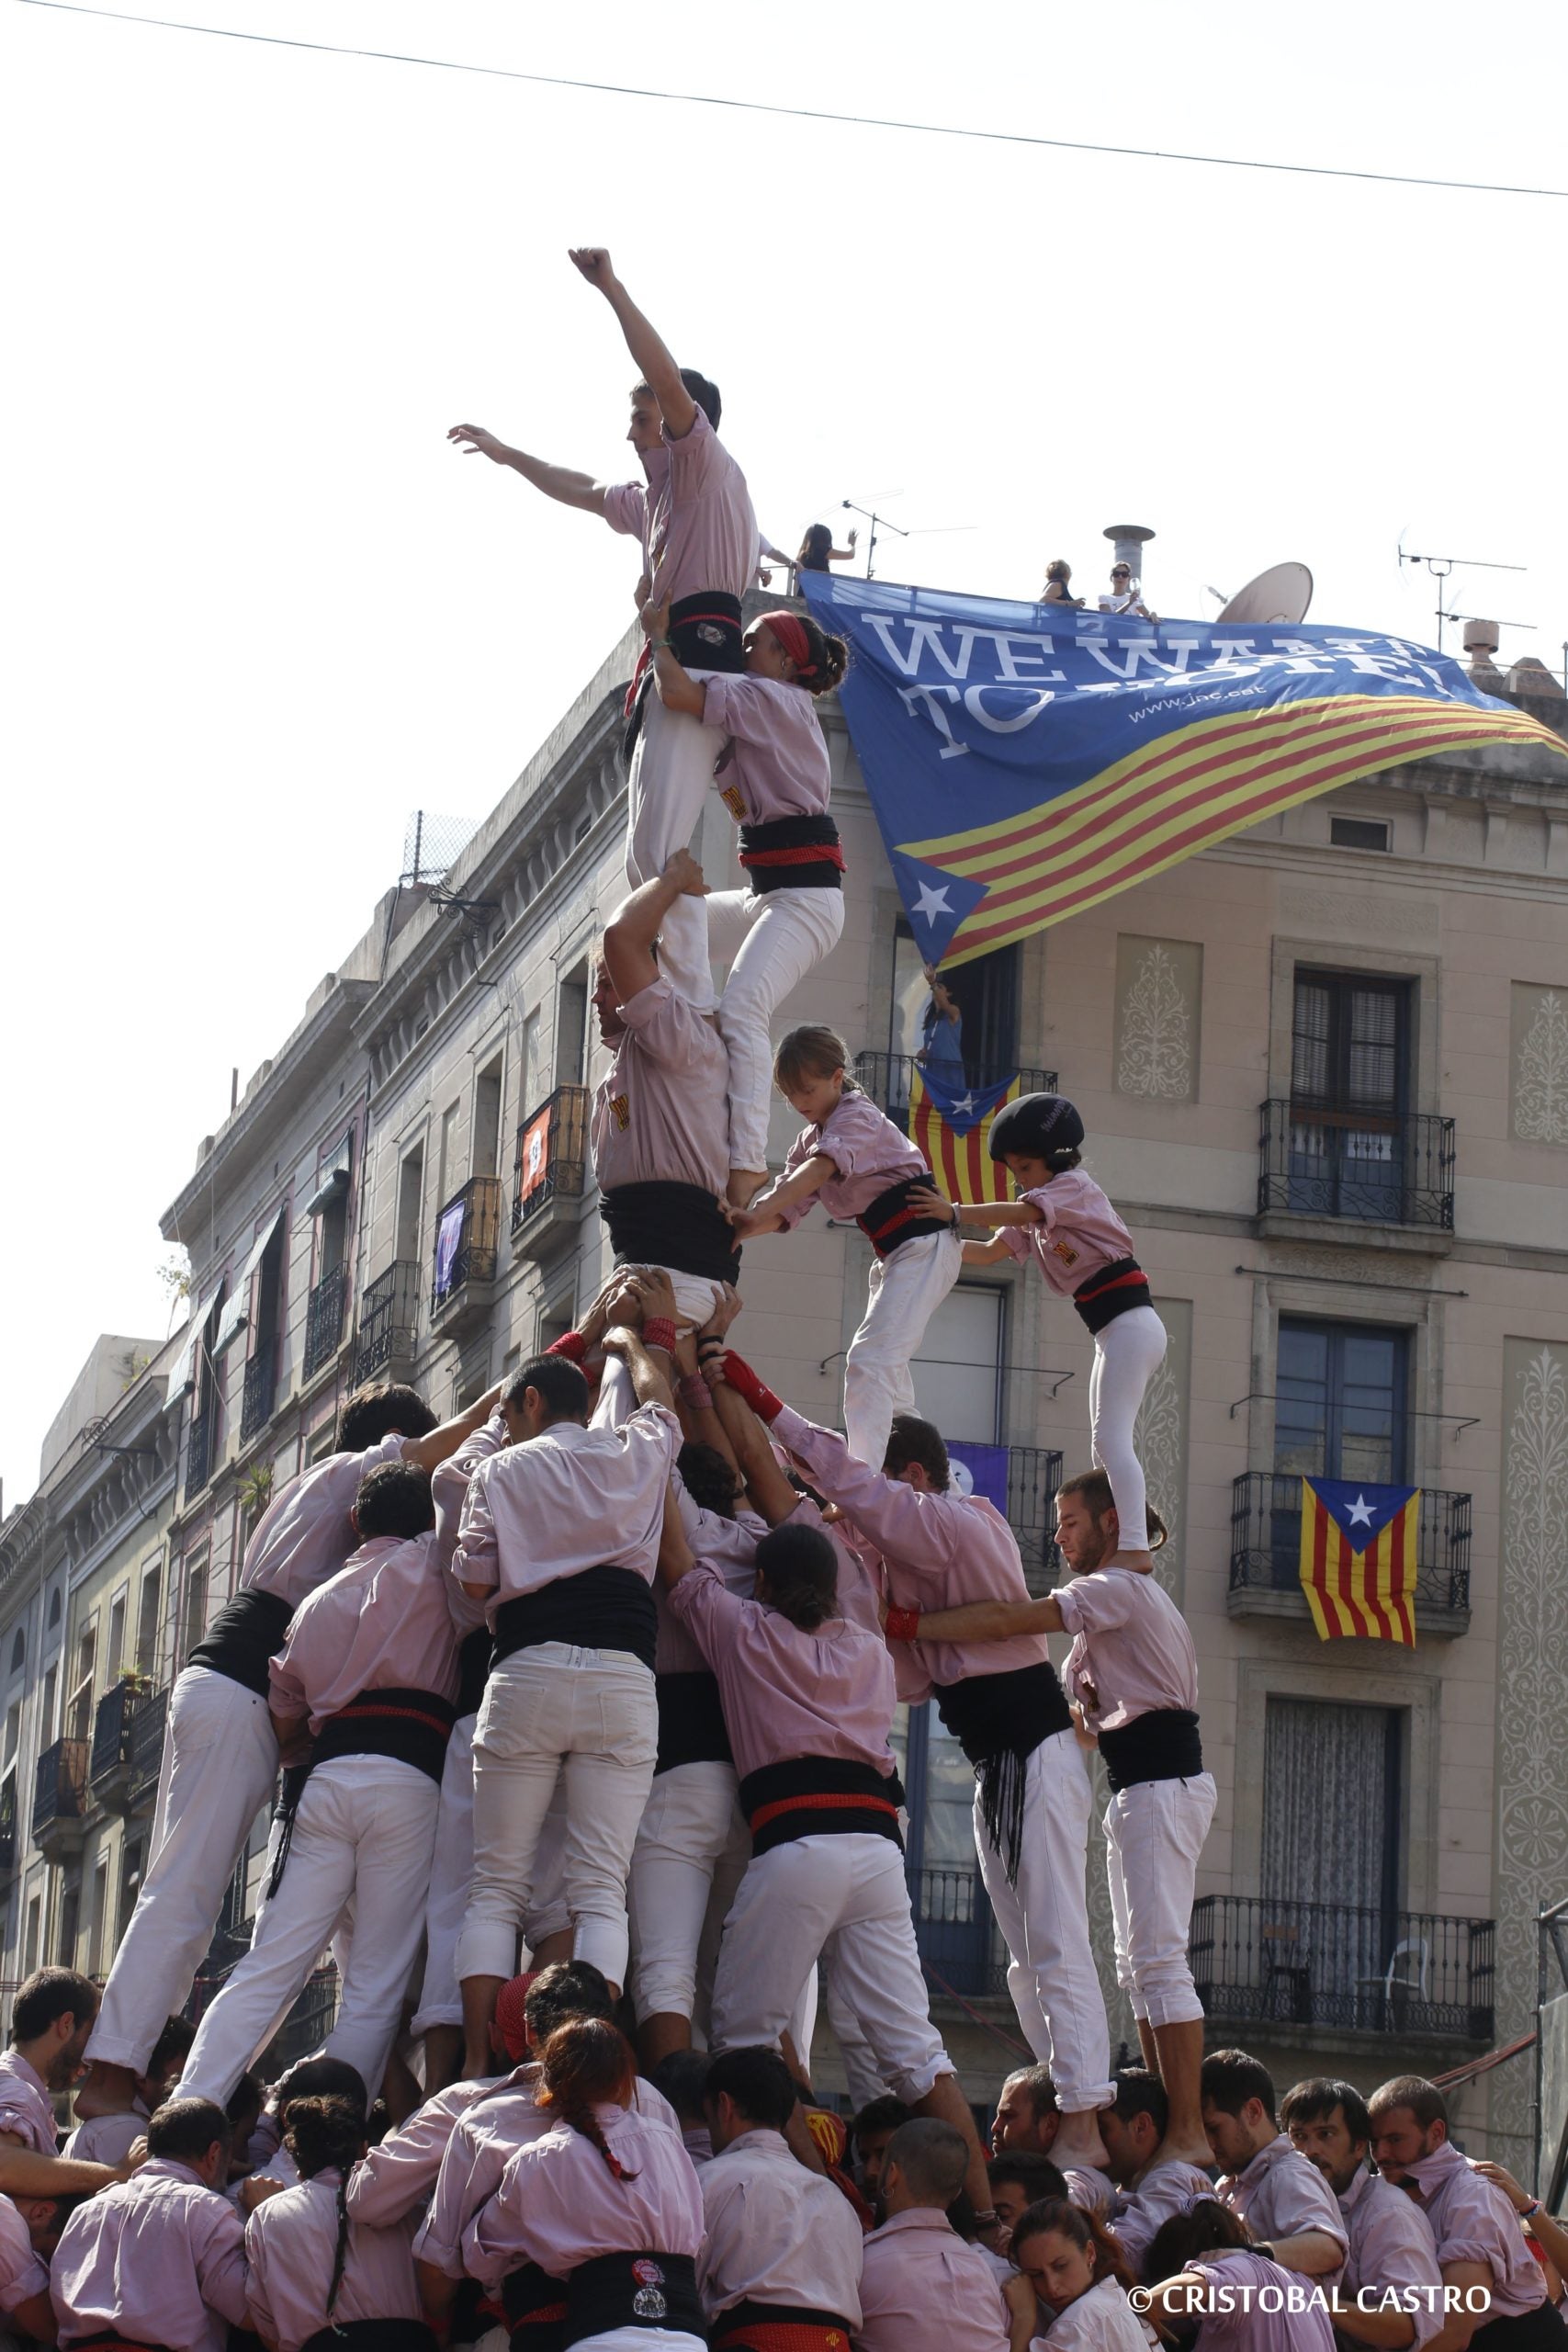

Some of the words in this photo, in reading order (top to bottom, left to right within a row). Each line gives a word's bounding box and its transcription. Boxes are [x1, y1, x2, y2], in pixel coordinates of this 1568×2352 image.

[861, 614, 1067, 681] WE
[897, 684, 1055, 760] TO
[1075, 653, 1456, 698] OTE!
[1128, 684, 1268, 723] www.jnc.cat
